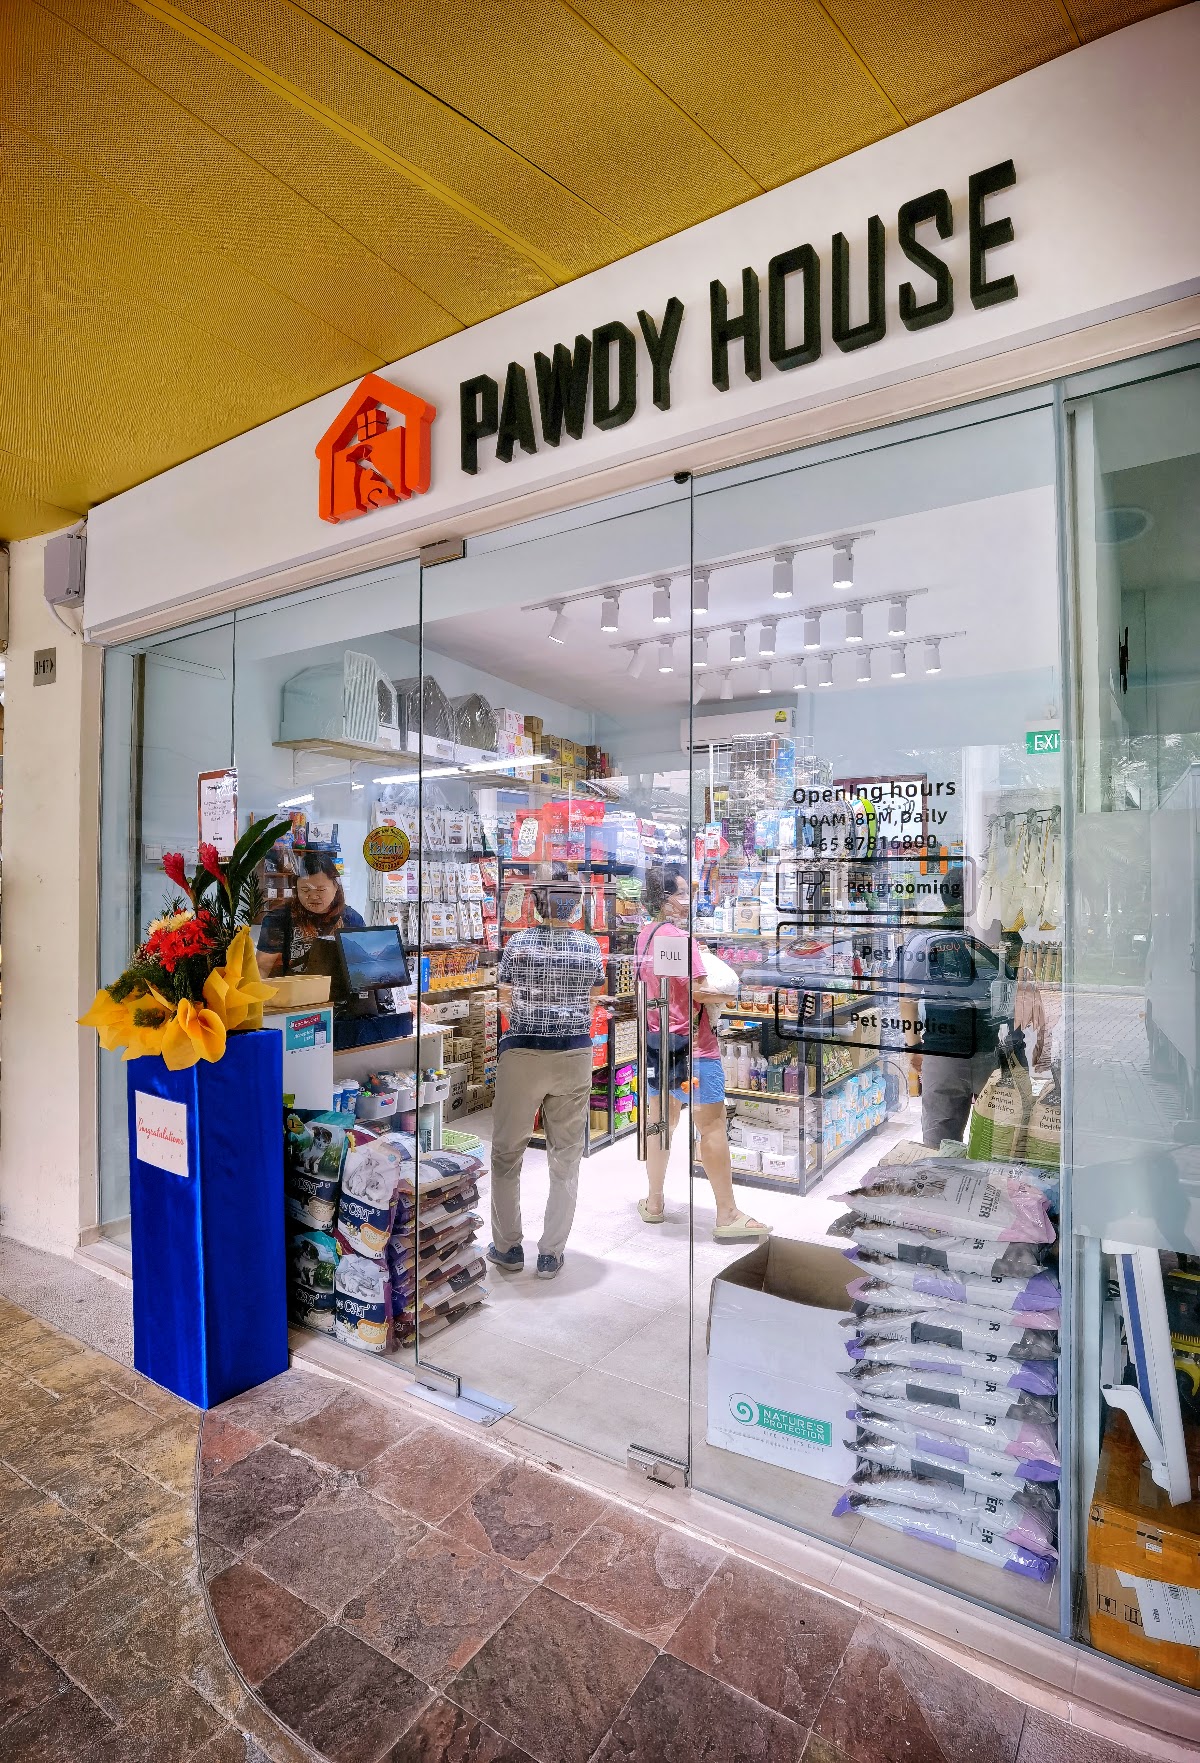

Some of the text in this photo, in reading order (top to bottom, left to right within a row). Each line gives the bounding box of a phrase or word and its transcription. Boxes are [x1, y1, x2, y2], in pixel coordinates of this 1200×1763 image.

[460, 158, 1018, 475] PAWDY HOUSE
[793, 781, 956, 807] Opening hours
[876, 879, 961, 897] grooming
[660, 950, 682, 961] PULL
[862, 945, 937, 962] Pet food
[851, 1013, 957, 1035] Pet supplies
[991, 1096, 1014, 1106] Animal
[138, 1117, 185, 1146] Congratulations
[763, 1409, 825, 1433] NATURE'S
[763, 1418, 825, 1441] PROTECTION
